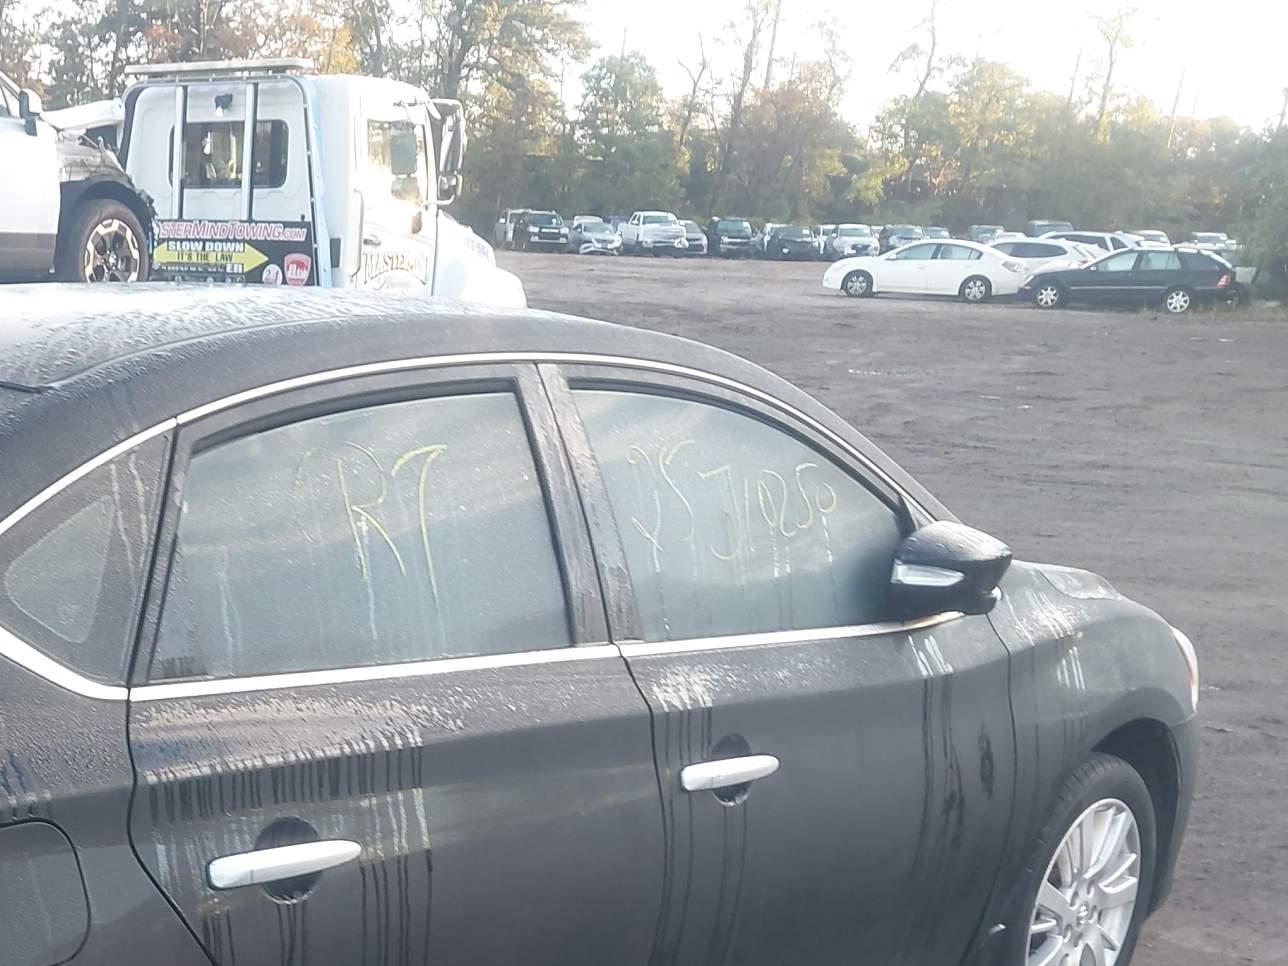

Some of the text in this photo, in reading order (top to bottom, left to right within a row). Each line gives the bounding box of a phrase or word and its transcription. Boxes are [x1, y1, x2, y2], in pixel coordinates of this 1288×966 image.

[168, 240, 244, 252] SLOW DOWN
[215, 252, 233, 262] LAW
